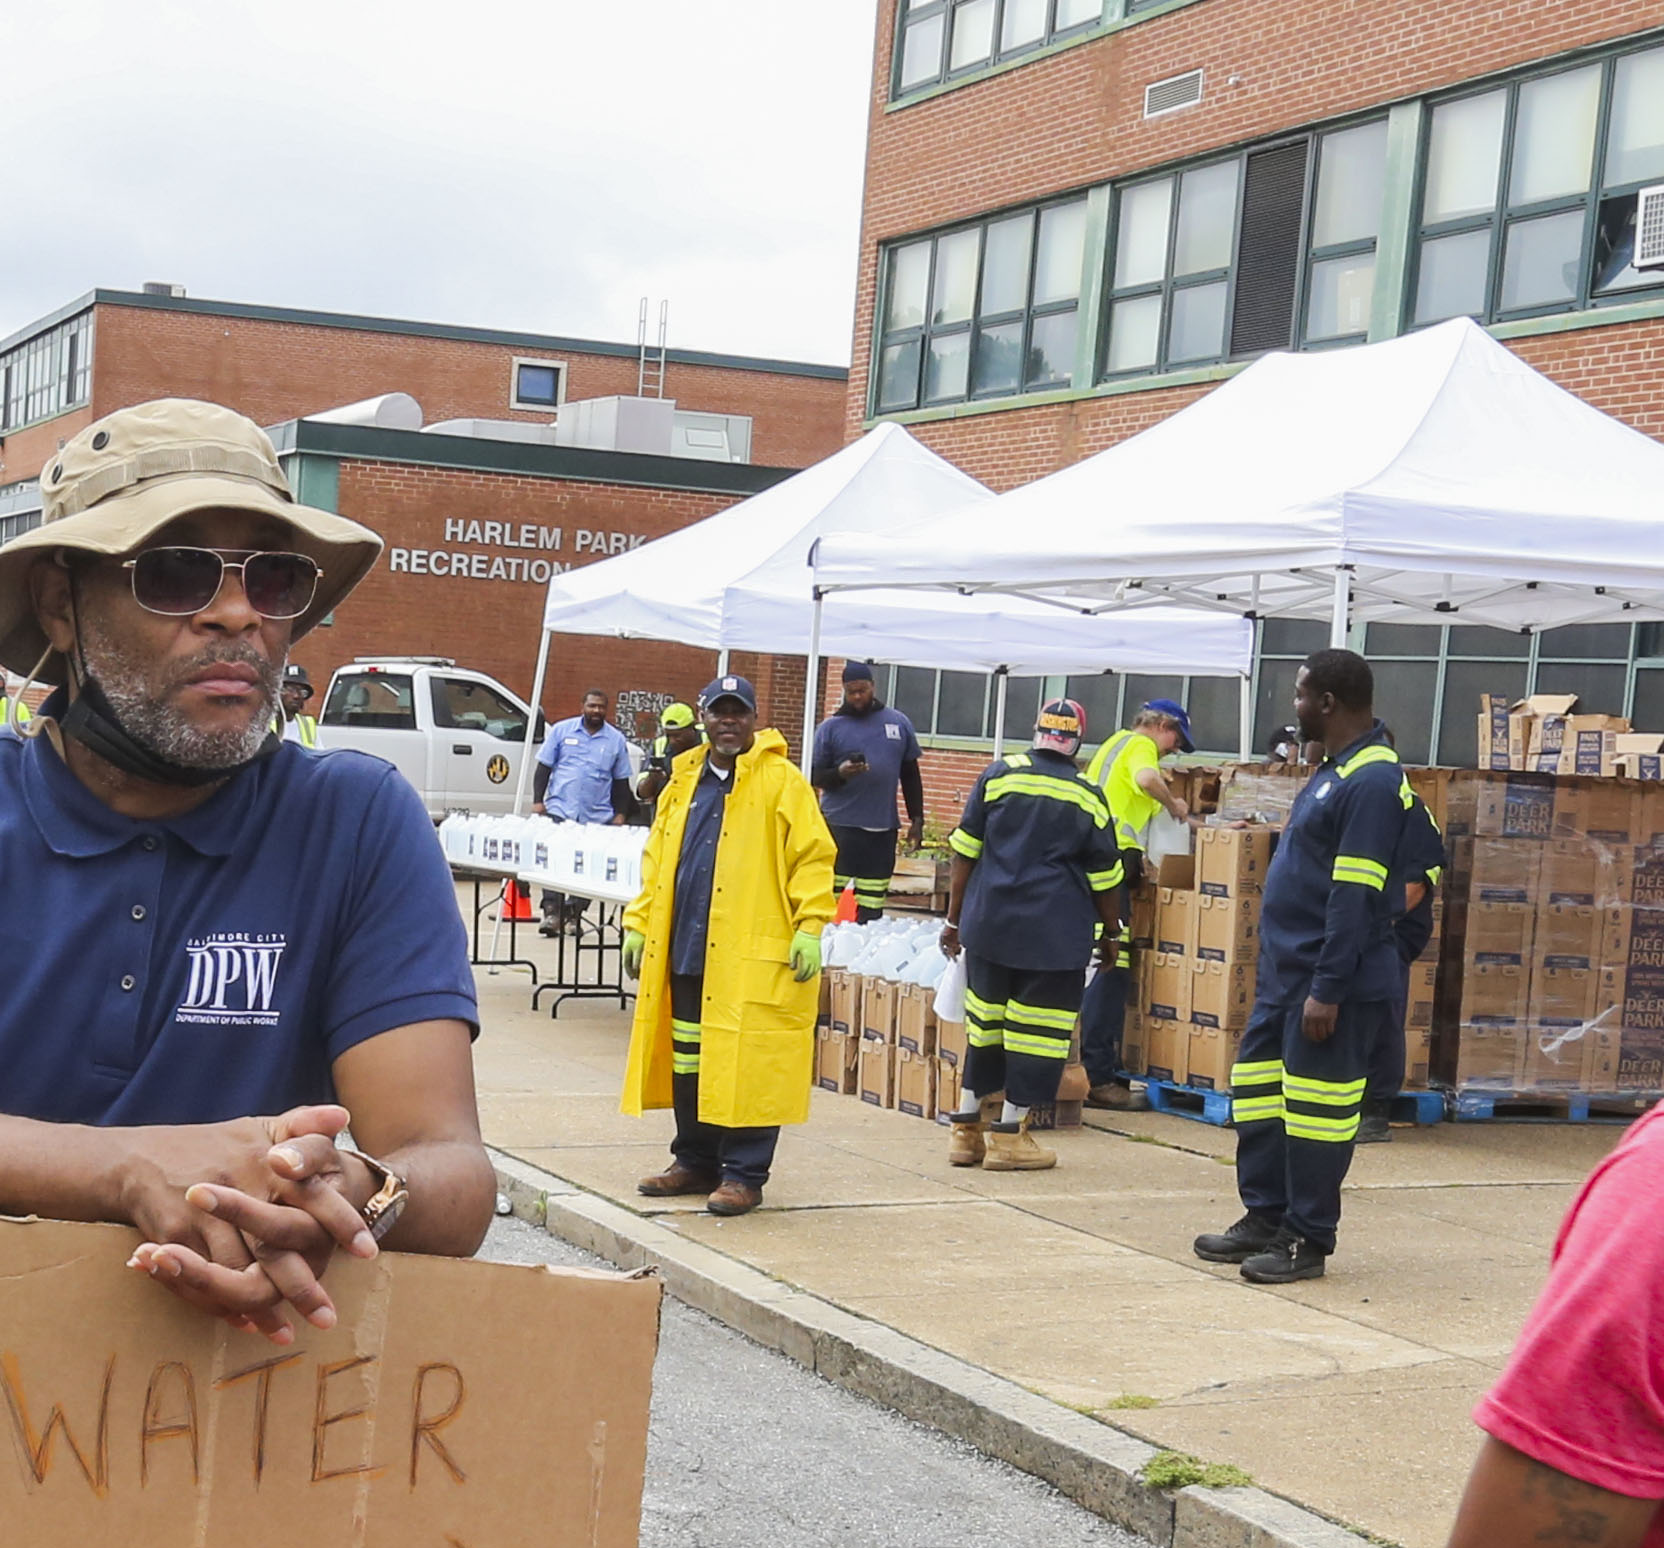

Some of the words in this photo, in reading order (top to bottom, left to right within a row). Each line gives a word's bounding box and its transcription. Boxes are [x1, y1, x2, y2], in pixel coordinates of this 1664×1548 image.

[444, 517, 562, 551] HARLEM
[1509, 802, 1550, 818] DEER
[1507, 818, 1548, 834] PARK
[256, 933, 286, 943] CITY
[181, 947, 284, 1010] DPW
[1624, 1013, 1664, 1028] PARK
[1620, 1059, 1662, 1073] DEER
[1031, 1110, 1052, 1127] RK
